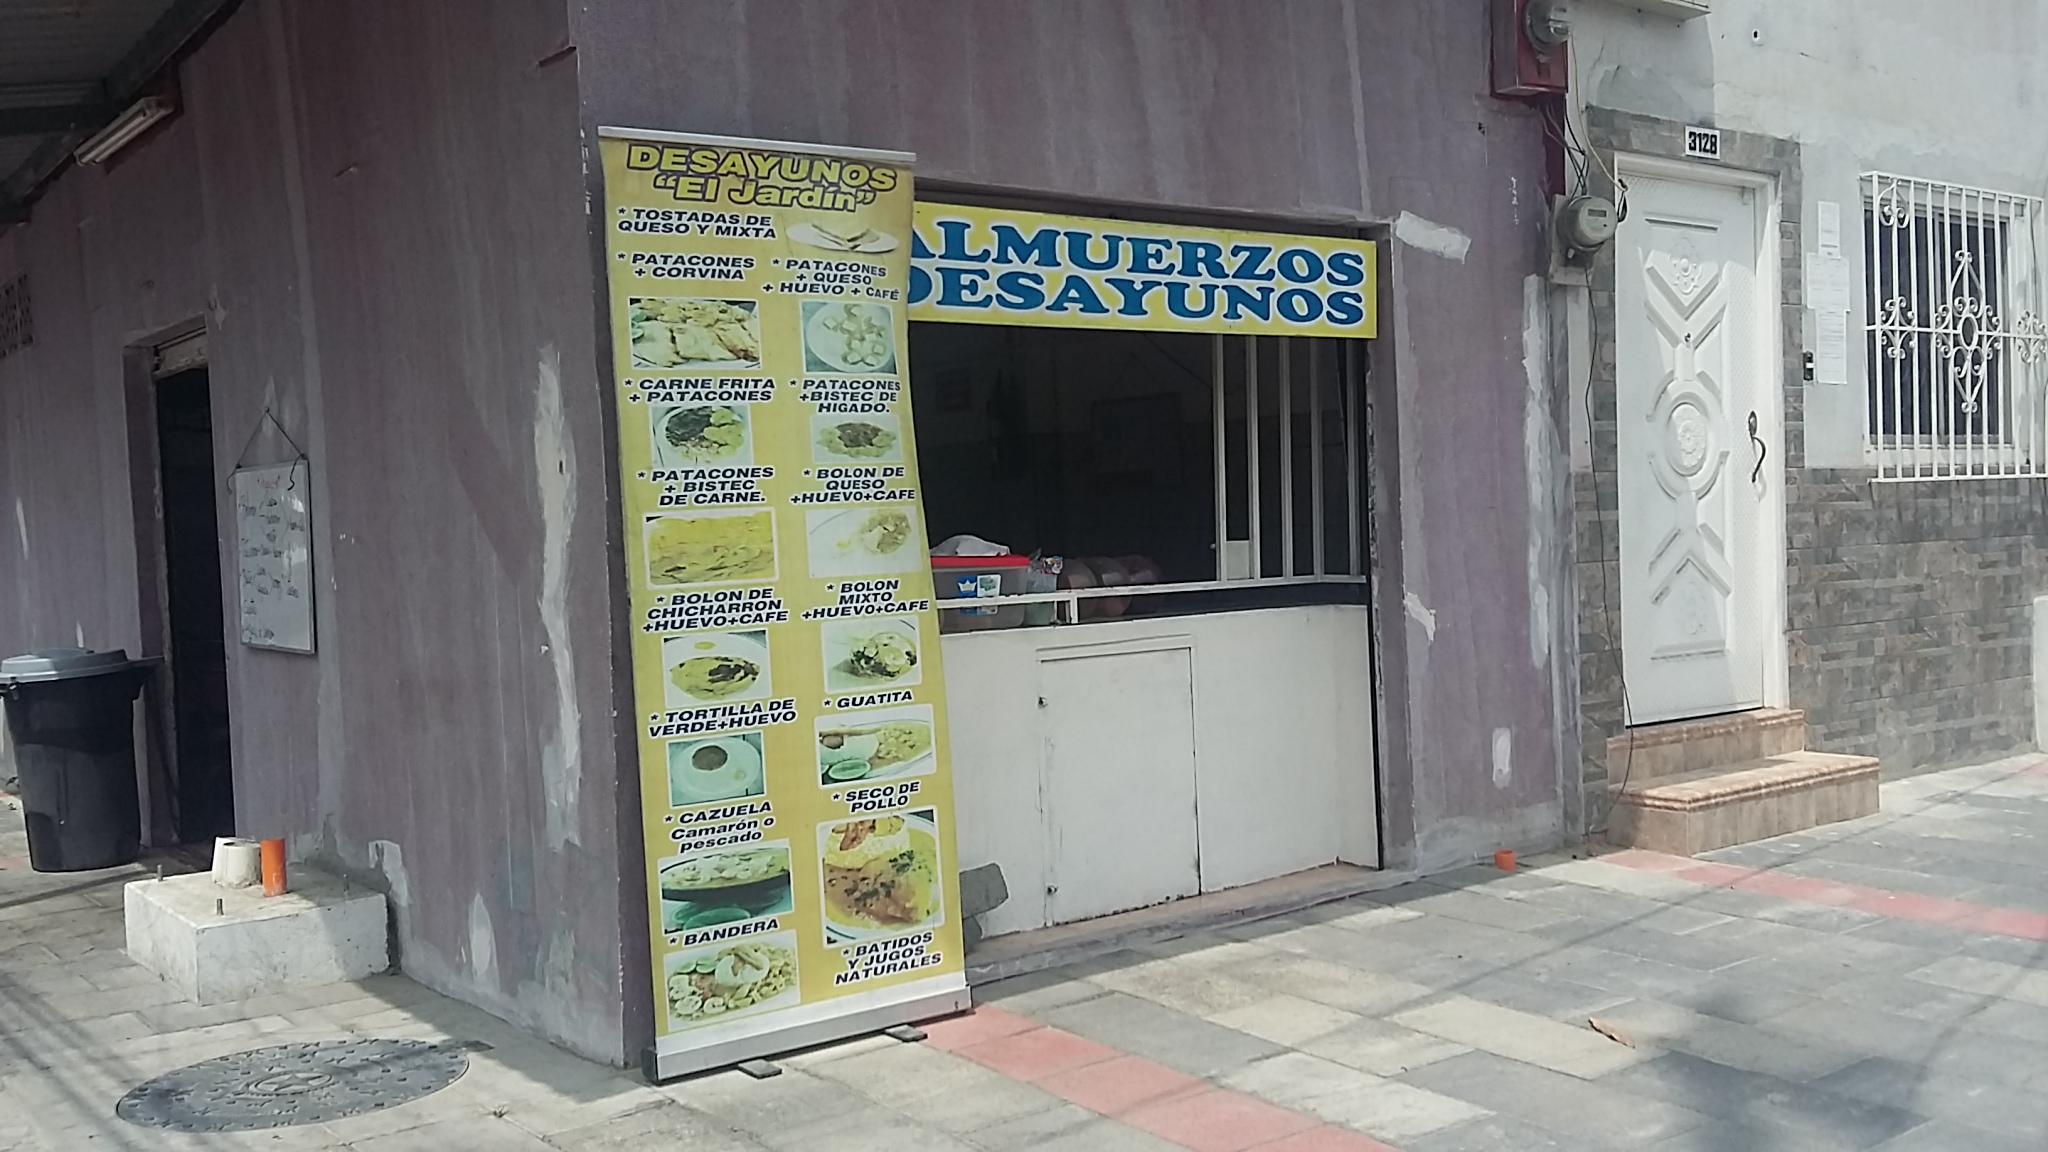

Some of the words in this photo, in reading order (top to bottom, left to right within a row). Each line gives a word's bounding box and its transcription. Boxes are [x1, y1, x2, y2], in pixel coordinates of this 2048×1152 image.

[1688, 131, 1717, 154] 3128
[627, 144, 898, 191] DESAYUNOS
[633, 209, 740, 225] TOSTADAS
[746, 215, 772, 227] DE
[618, 220, 690, 235] QUESO
[696, 225, 711, 236] Y
[715, 225, 777, 239] MIXTA
[632, 253, 755, 268] PATACONES
[786, 259, 887, 277] PATACONES
[652, 266, 744, 280] CORVINA
[813, 272, 872, 285] QUESO
[780, 283, 845, 296] HUEVO
[866, 286, 899, 300] CAFÉ
[639, 379, 714, 390] CARNE
[718, 378, 775, 389] FRITA
[803, 380, 900, 391] PATACONES
[647, 390, 772, 402] PATACONES
[879, 391, 897, 402] DE
[652, 467, 774, 481] PATACONES
[817, 468, 876, 479] BOLON
[882, 467, 905, 477] DE
[683, 480, 755, 492] BISTEC
[826, 479, 885, 490] QUESO
[659, 495, 690, 506] DE
[693, 491, 766, 504] CARNE.
[841, 580, 899, 592] BOLON
[672, 590, 745, 605] BOLON
[749, 588, 773, 600] DE
[839, 592, 893, 604] MIXTO
[647, 600, 782, 620] CHICHARRON
[837, 691, 913, 708] GUATITA
[665, 702, 761, 723] TORTILLA
[768, 699, 794, 712] DE
[649, 710, 797, 737] VERDE+HUEVO
[845, 786, 894, 802] SECO
[898, 782, 920, 794] DE
[850, 795, 908, 812] POLLO
[679, 802, 772, 823] CAZUELA
[671, 819, 758, 840] Camarón
[763, 817, 774, 827] o
[680, 830, 762, 853] pescado
[684, 919, 779, 945] BANDERA
[855, 932, 933, 957] BATIDOS
[848, 959, 860, 970] Y
[864, 945, 925, 967] JUGOS
[835, 953, 942, 985] NATURALES
